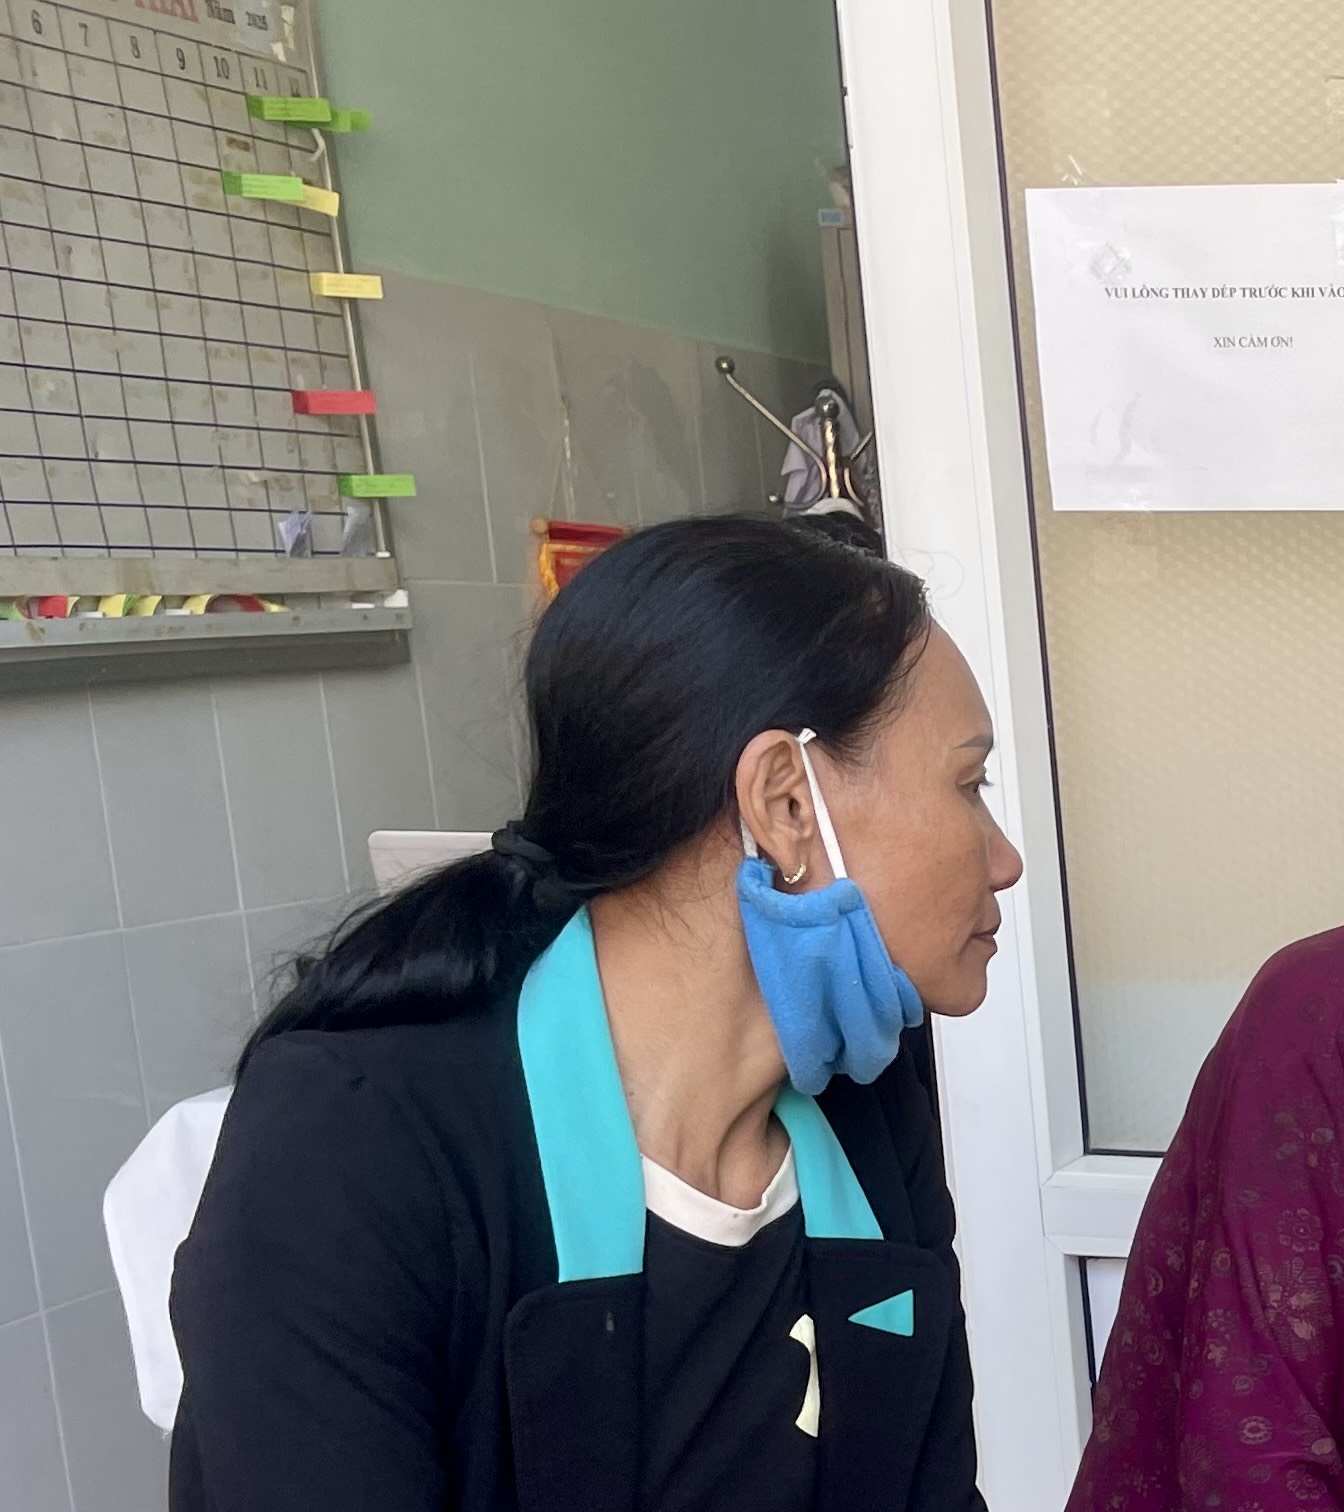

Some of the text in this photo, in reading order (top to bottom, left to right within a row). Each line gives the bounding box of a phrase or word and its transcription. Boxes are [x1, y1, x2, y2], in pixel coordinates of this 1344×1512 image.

[30, 9, 43, 35] 6
[78, 22, 89, 48] 7
[175, 47, 186, 71] 9
[213, 55, 230, 80] 10
[253, 66, 268, 90] 11
[1104, 287, 1128, 299] VUI
[1132, 284, 1169, 299] LÒNG
[1172, 287, 1208, 299] THAY
[1291, 286, 1315, 298] KHI
[1213, 335, 1236, 348] XIN
